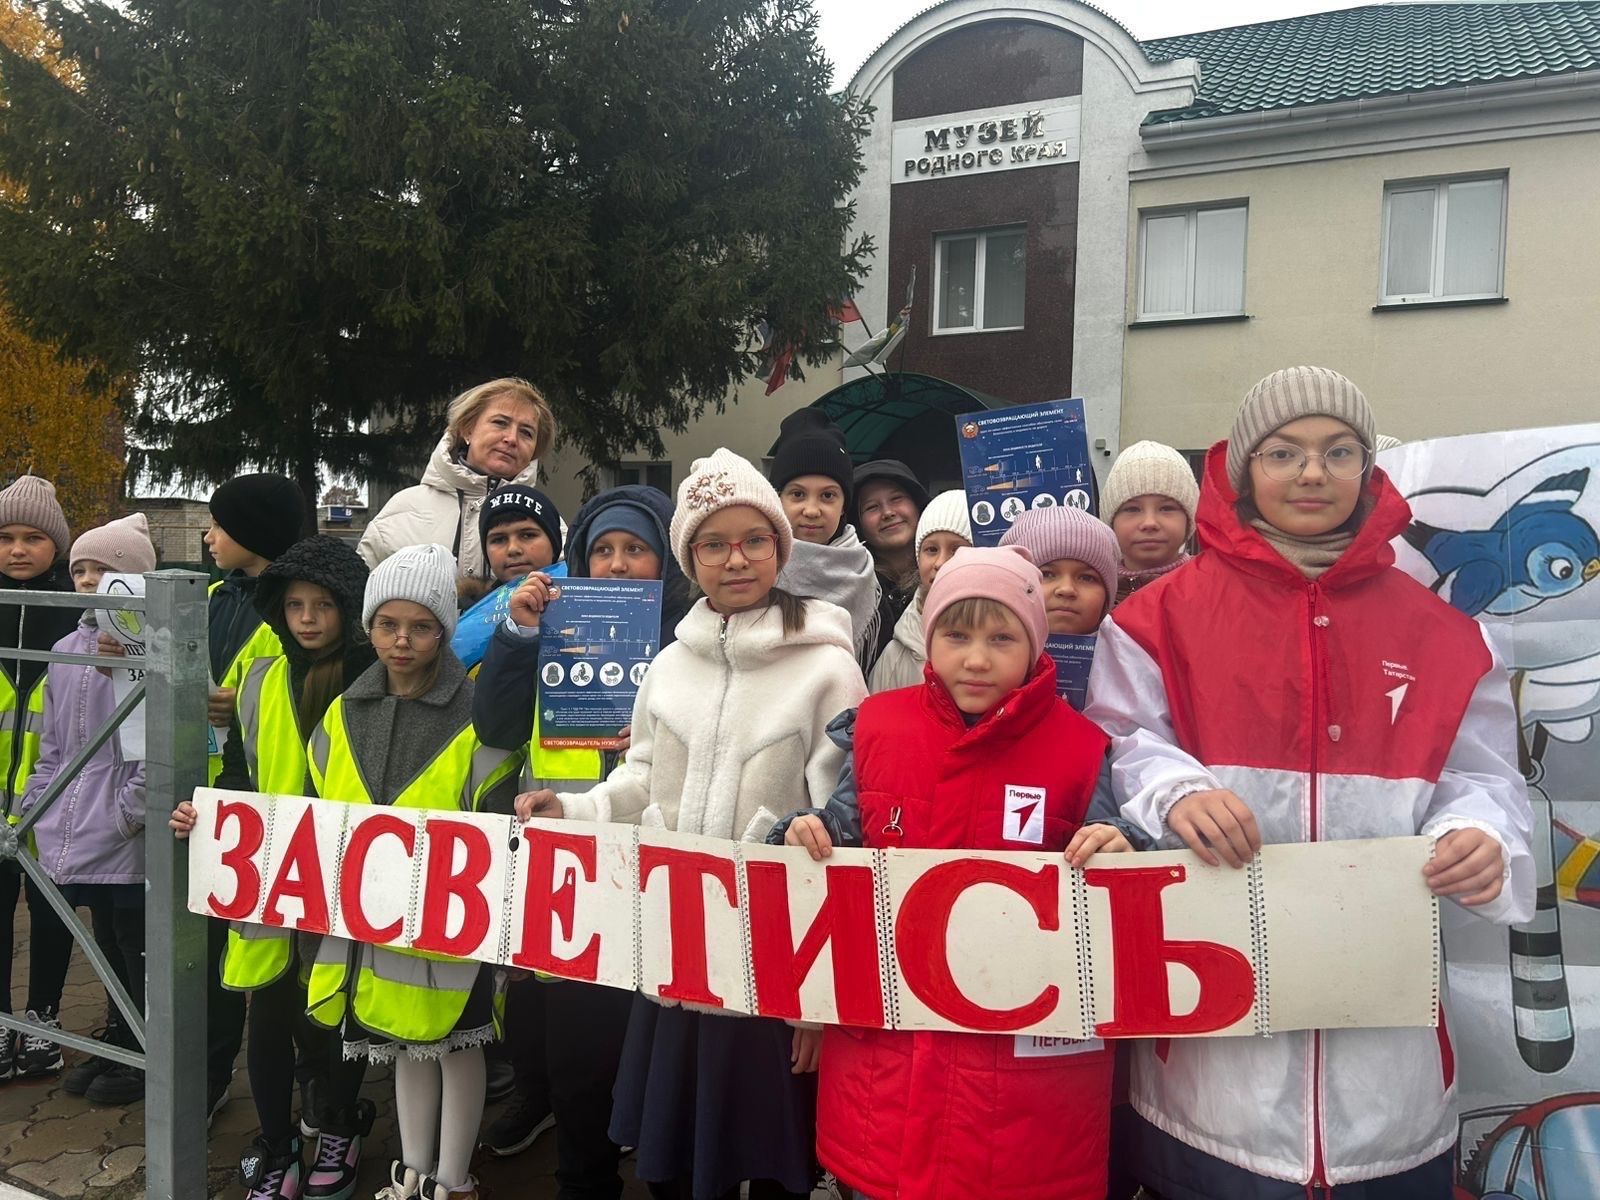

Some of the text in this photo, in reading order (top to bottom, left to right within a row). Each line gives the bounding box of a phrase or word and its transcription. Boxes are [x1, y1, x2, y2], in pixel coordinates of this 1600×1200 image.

[924, 109, 1045, 152] МУЗЕЙ
[904, 140, 1068, 177] РОДНОГО КРАЯ
[977, 408, 1064, 426] СВЕТОВОЗВРАЩАЮЩИЙ ЭЛЕМЕНТ
[489, 493, 543, 516] WHITE
[543, 739, 600, 747] СВЕТОВОЗВРАЩАТЕЛЬ
[1009, 789, 1042, 800] Первые
[206, 799, 1255, 1037] ЗАСВЕТИСЬ
